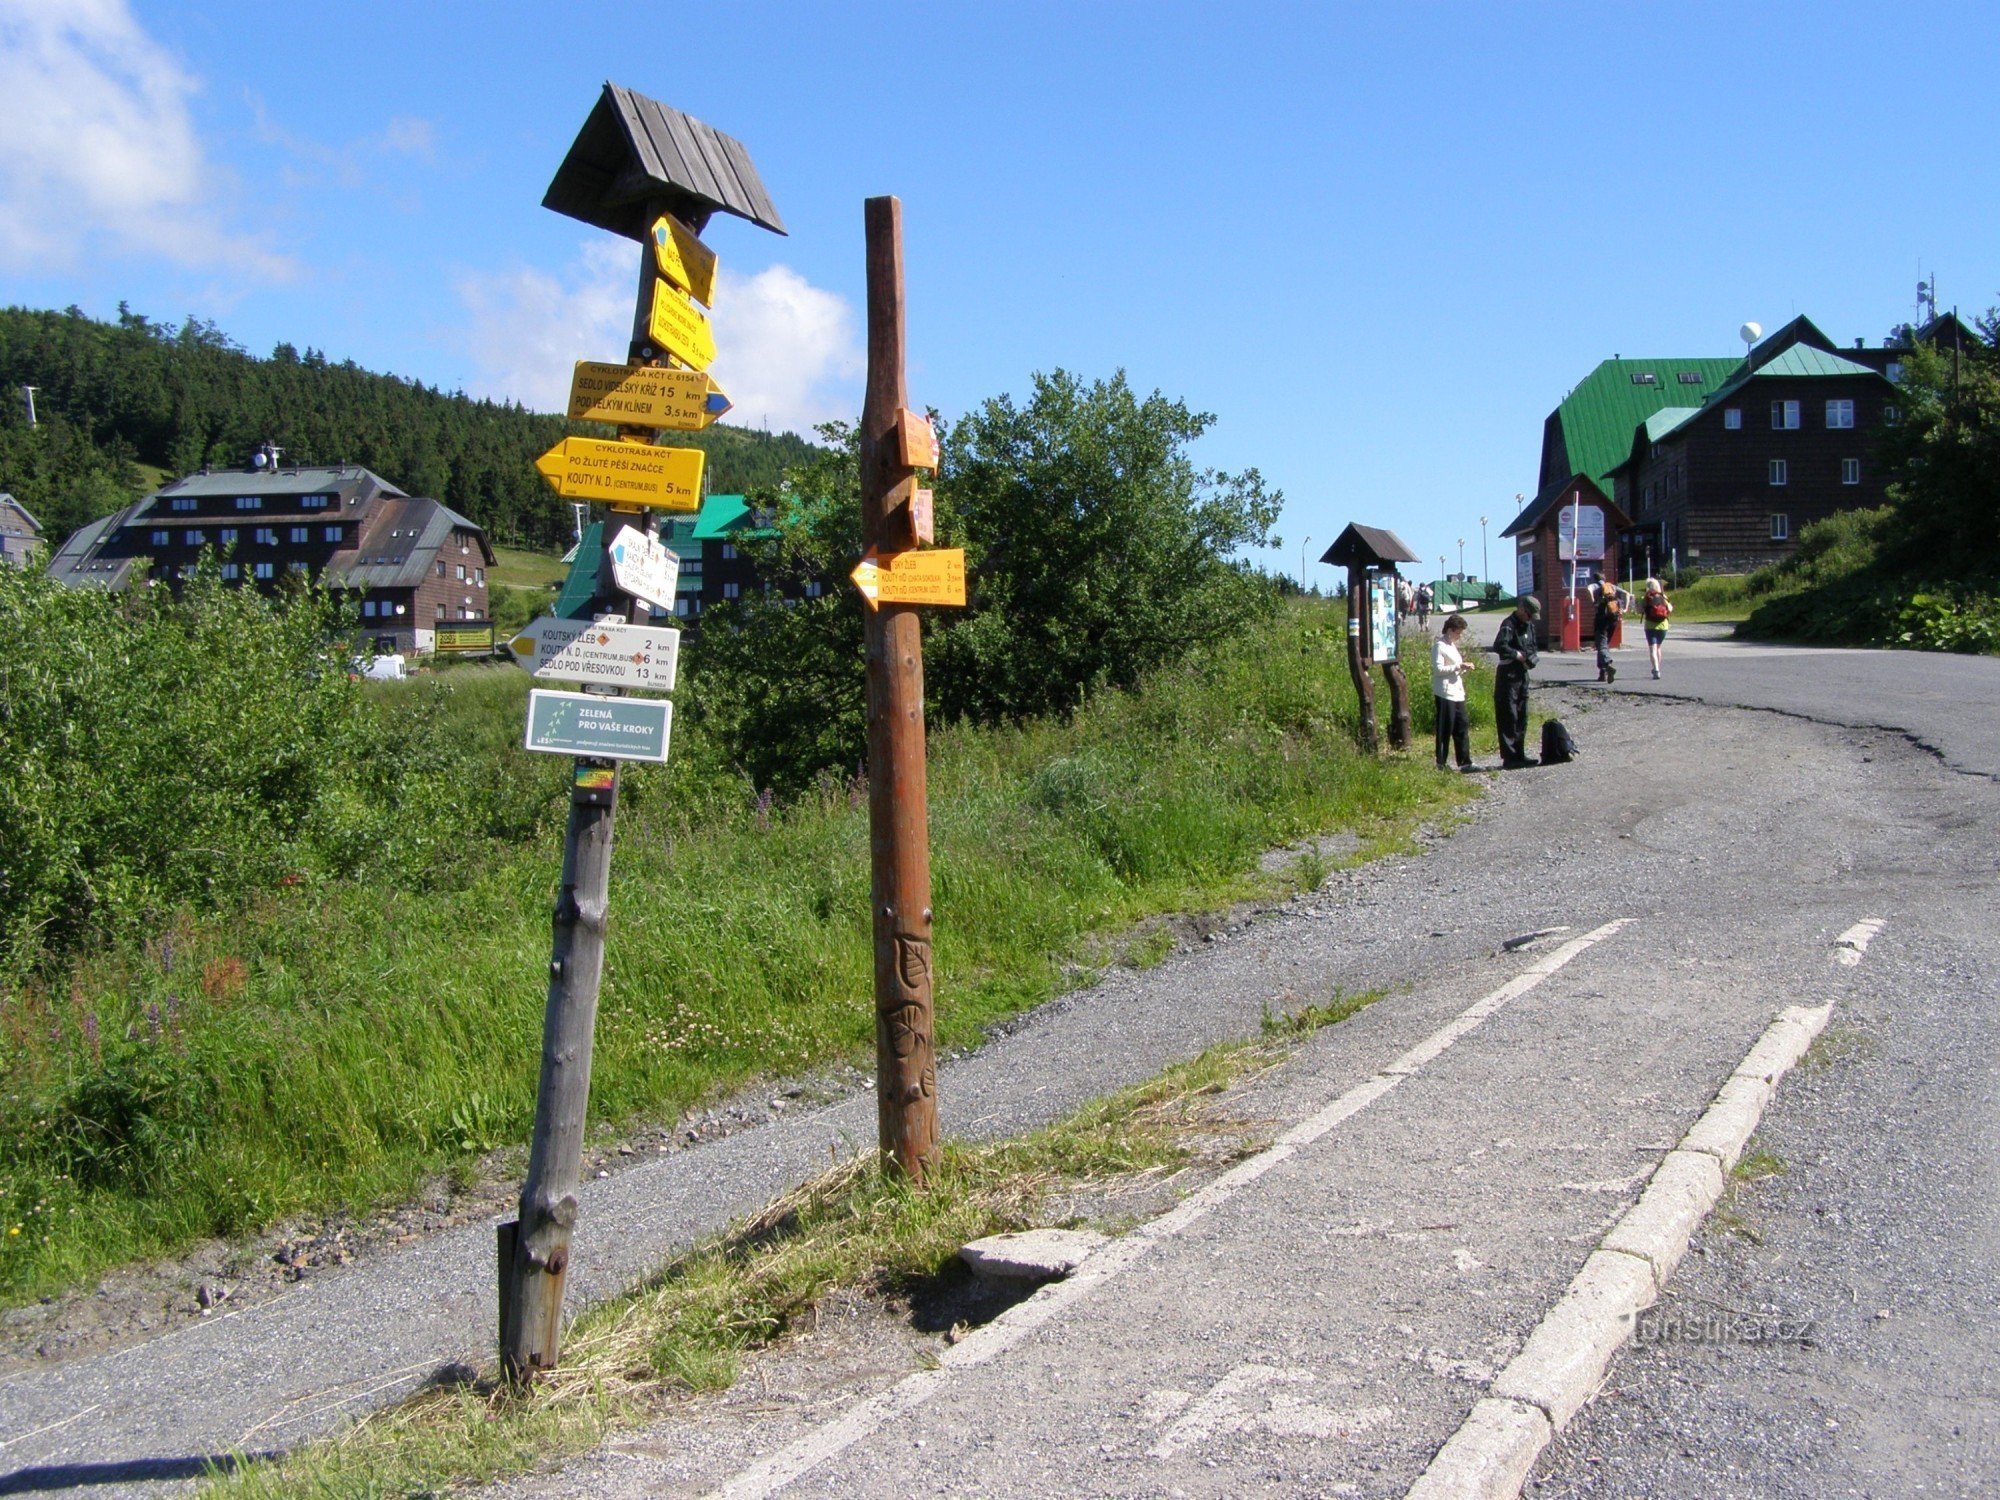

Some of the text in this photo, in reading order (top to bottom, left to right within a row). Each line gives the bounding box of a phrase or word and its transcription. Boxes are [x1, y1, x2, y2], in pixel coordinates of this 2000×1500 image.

[590, 365, 694, 383] CYKLOTRASA KČT č. 6154
[578, 378, 701, 401] SEDLO VIDELSKÝ KŘÍŽ 15 km
[576, 395, 698, 419] POD VELKÝM KLÍNEM 3,5 km
[595, 444, 672, 460] CYKLOTRASA KČT
[569, 456, 581, 466] PO
[582, 455, 609, 468] ŽLUTÉ
[631, 461, 664, 475] ZNAČCE
[566, 472, 595, 486] KOUTY
[595, 476, 604, 487] N.
[605, 477, 613, 488] D.
[666, 482, 674, 494] 5
[676, 486, 691, 497] km
[947, 560, 952, 569] 2
[947, 584, 952, 594] 6
[543, 630, 670, 652] KOUTSKÝ ŽLEB 2 km
[541, 644, 669, 668] KOUTY N. D. (CENTRUM,BUS 6 km
[539, 658, 668, 682] SEDLO POD VŘESOVKOU 13 km
[579, 707, 613, 720] ZELENÁ
[578, 720, 655, 736] PRO VAŠE KROKY
